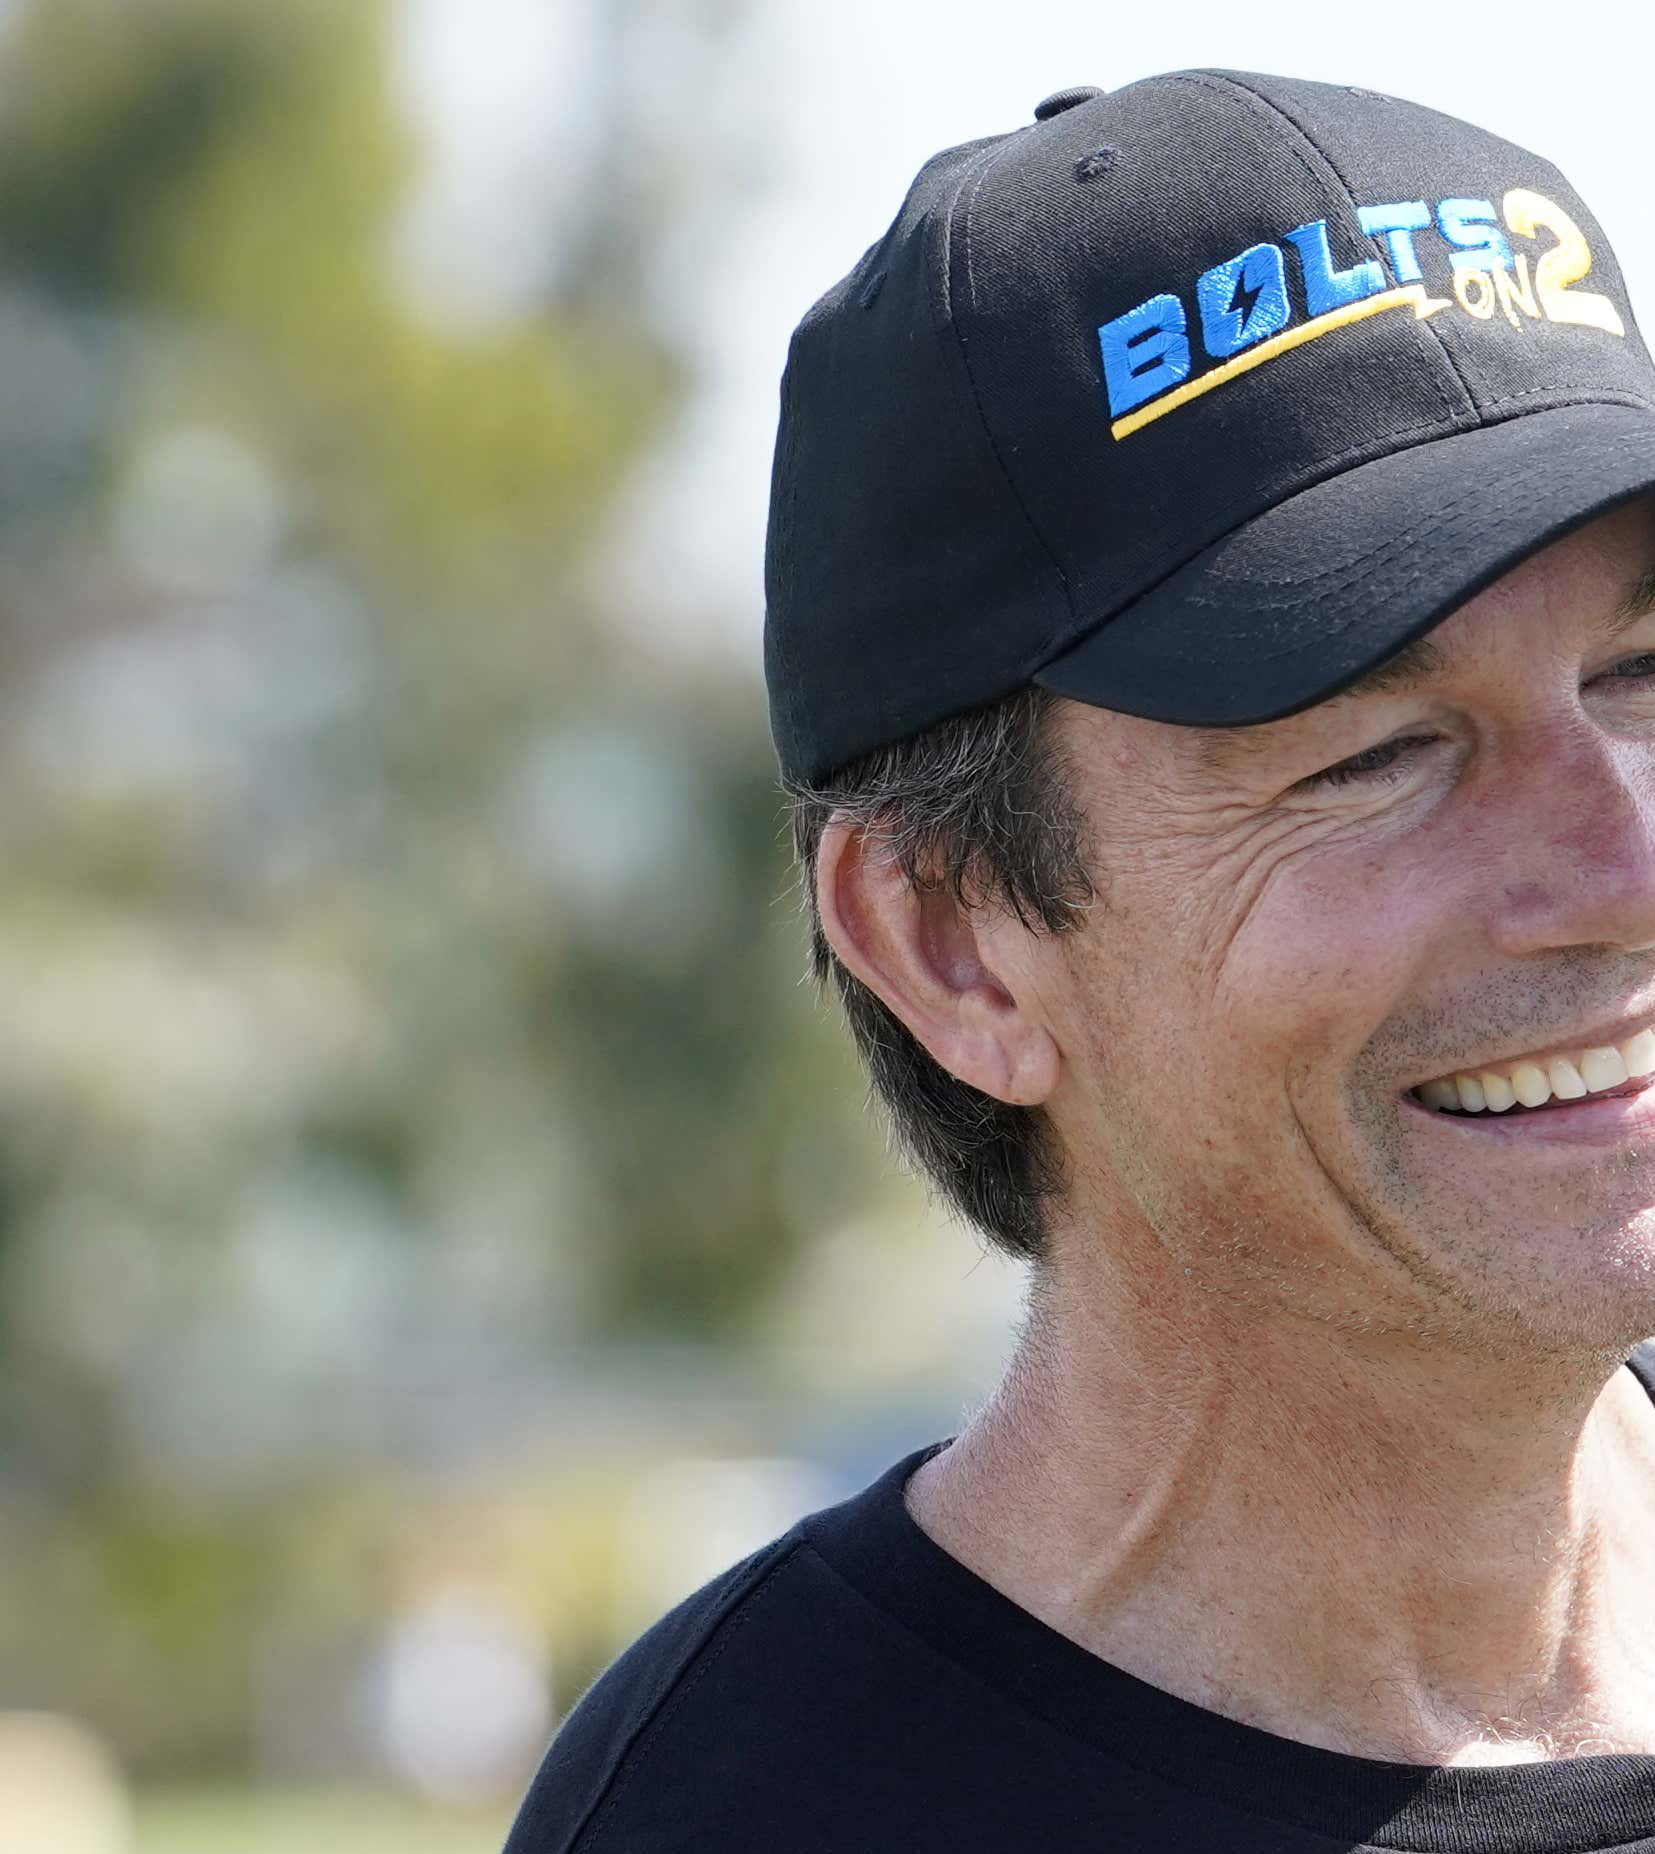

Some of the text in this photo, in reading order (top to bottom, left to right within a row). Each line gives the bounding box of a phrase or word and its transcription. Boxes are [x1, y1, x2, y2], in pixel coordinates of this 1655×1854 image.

[1098, 188, 1625, 419] BOLTS ON 2
